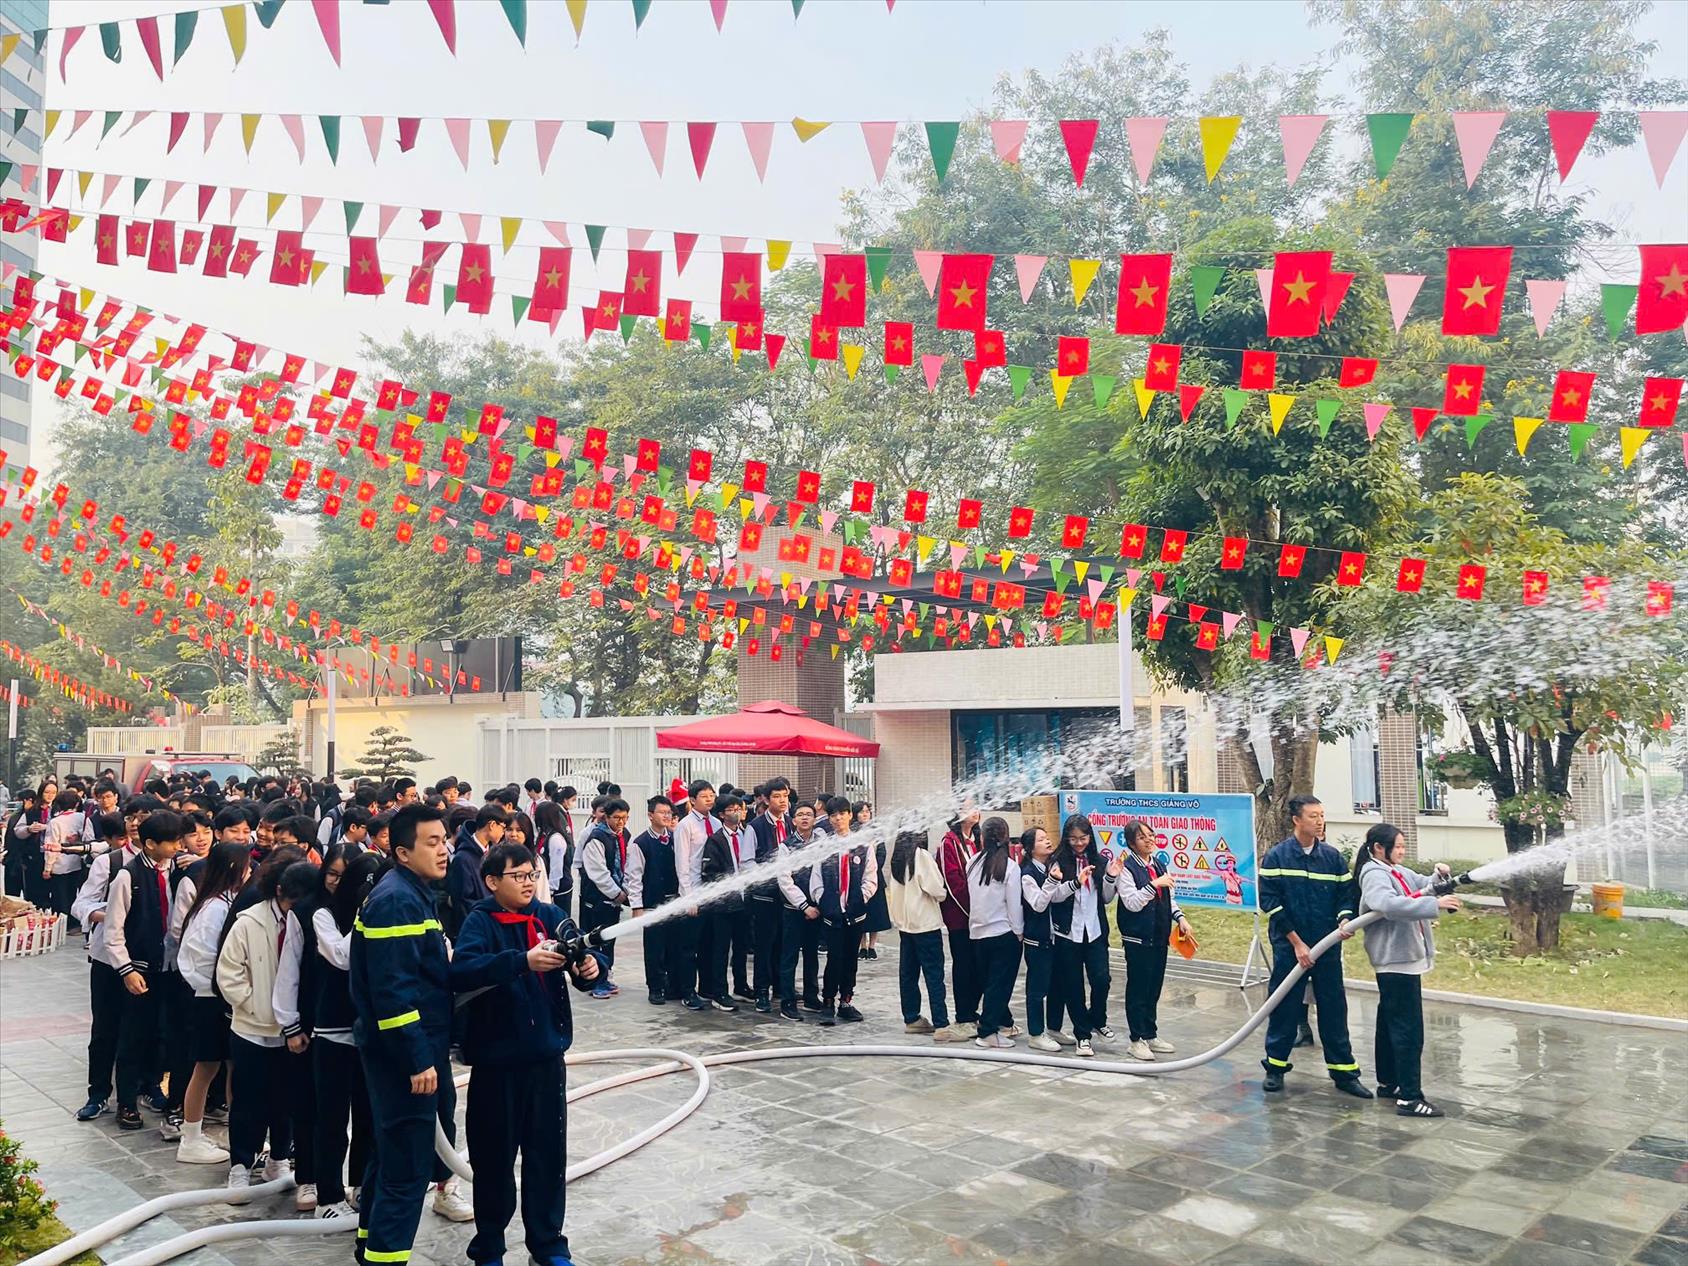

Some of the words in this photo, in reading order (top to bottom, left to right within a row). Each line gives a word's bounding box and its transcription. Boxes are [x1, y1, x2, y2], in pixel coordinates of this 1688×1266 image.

[1105, 797, 1137, 807] TRƯỜNG
[1138, 798, 1159, 808] THCS
[1171, 816, 1189, 830] GIAO
[1190, 815, 1216, 831] THÔNG
